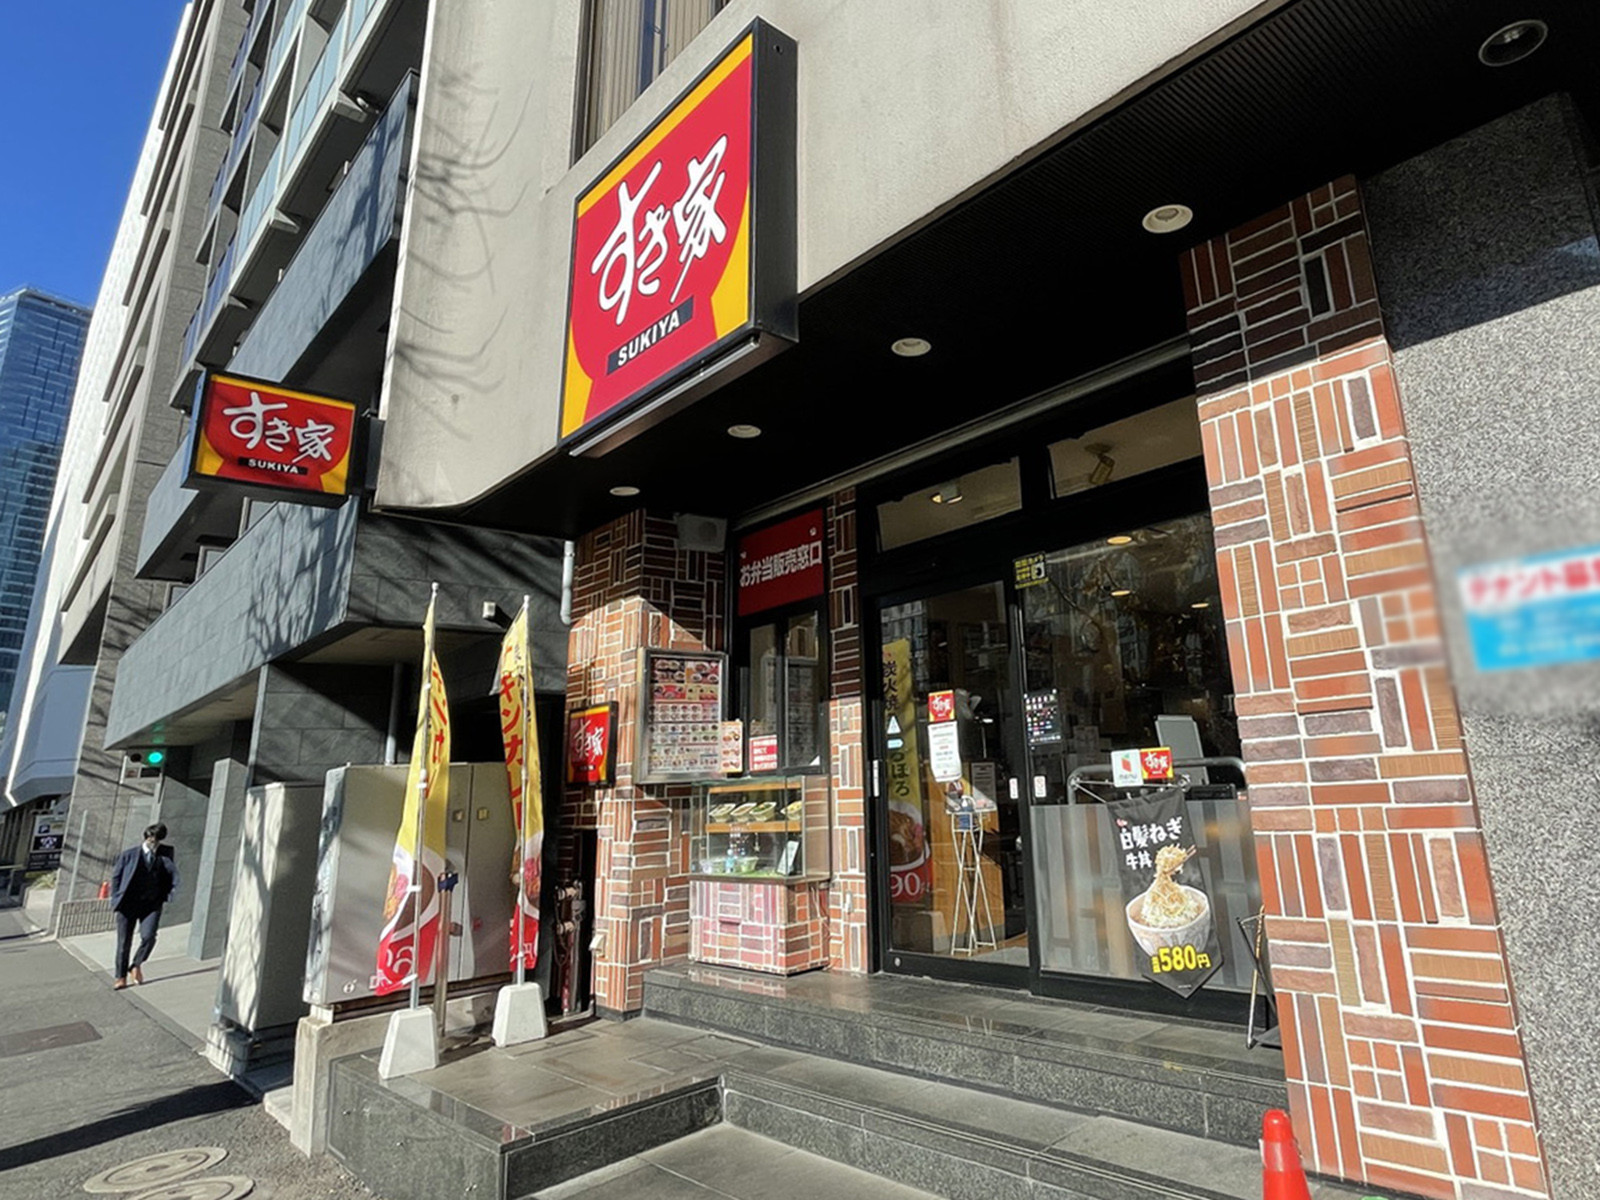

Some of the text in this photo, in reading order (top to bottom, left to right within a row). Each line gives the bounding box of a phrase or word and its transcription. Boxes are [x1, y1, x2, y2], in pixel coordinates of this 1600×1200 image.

[591, 134, 728, 325] すき家
[616, 313, 681, 367] SUKIYA
[222, 391, 335, 464] すき家
[248, 458, 299, 475] SUKIYA
[740, 540, 822, 588] お弁当販売窓口
[1119, 816, 1183, 850] 白髪ねぎ
[1126, 850, 1153, 871] 牛丼
[1158, 944, 1211, 972] 580円
